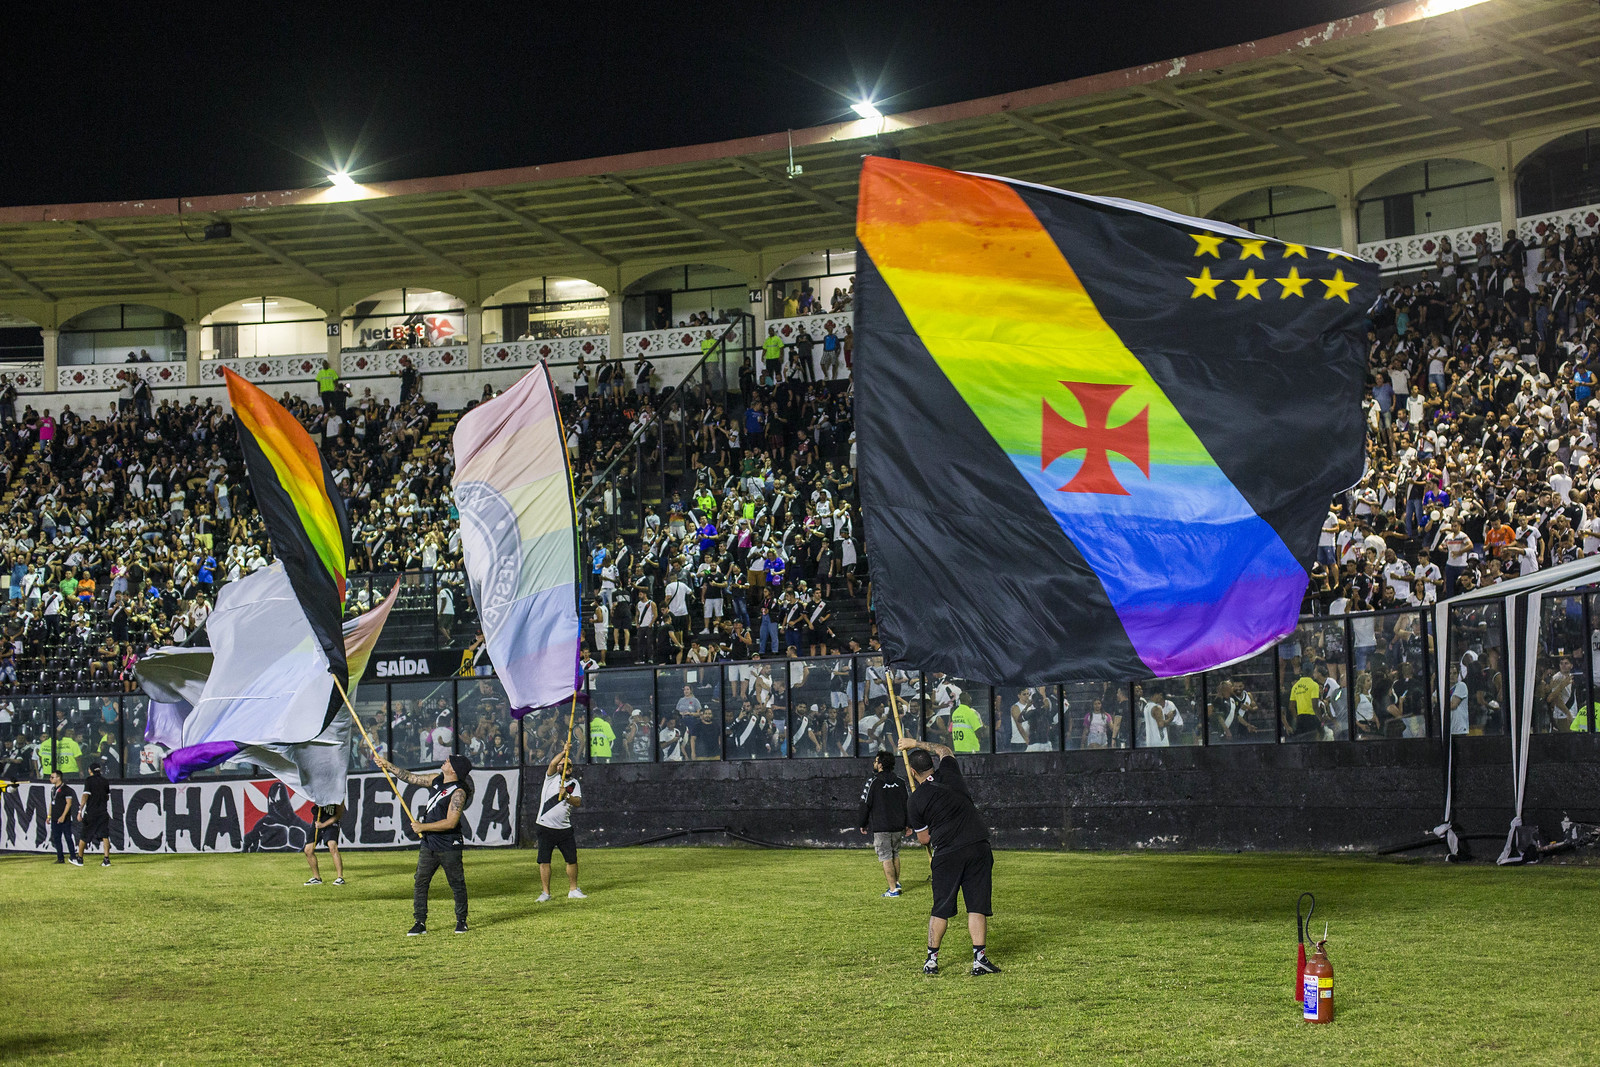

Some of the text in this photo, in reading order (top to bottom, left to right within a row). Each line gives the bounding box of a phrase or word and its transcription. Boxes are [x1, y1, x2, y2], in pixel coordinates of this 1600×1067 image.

[749, 291, 762, 302] 14
[327, 325, 339, 335] 13
[376, 656, 430, 677] SAÍDA
